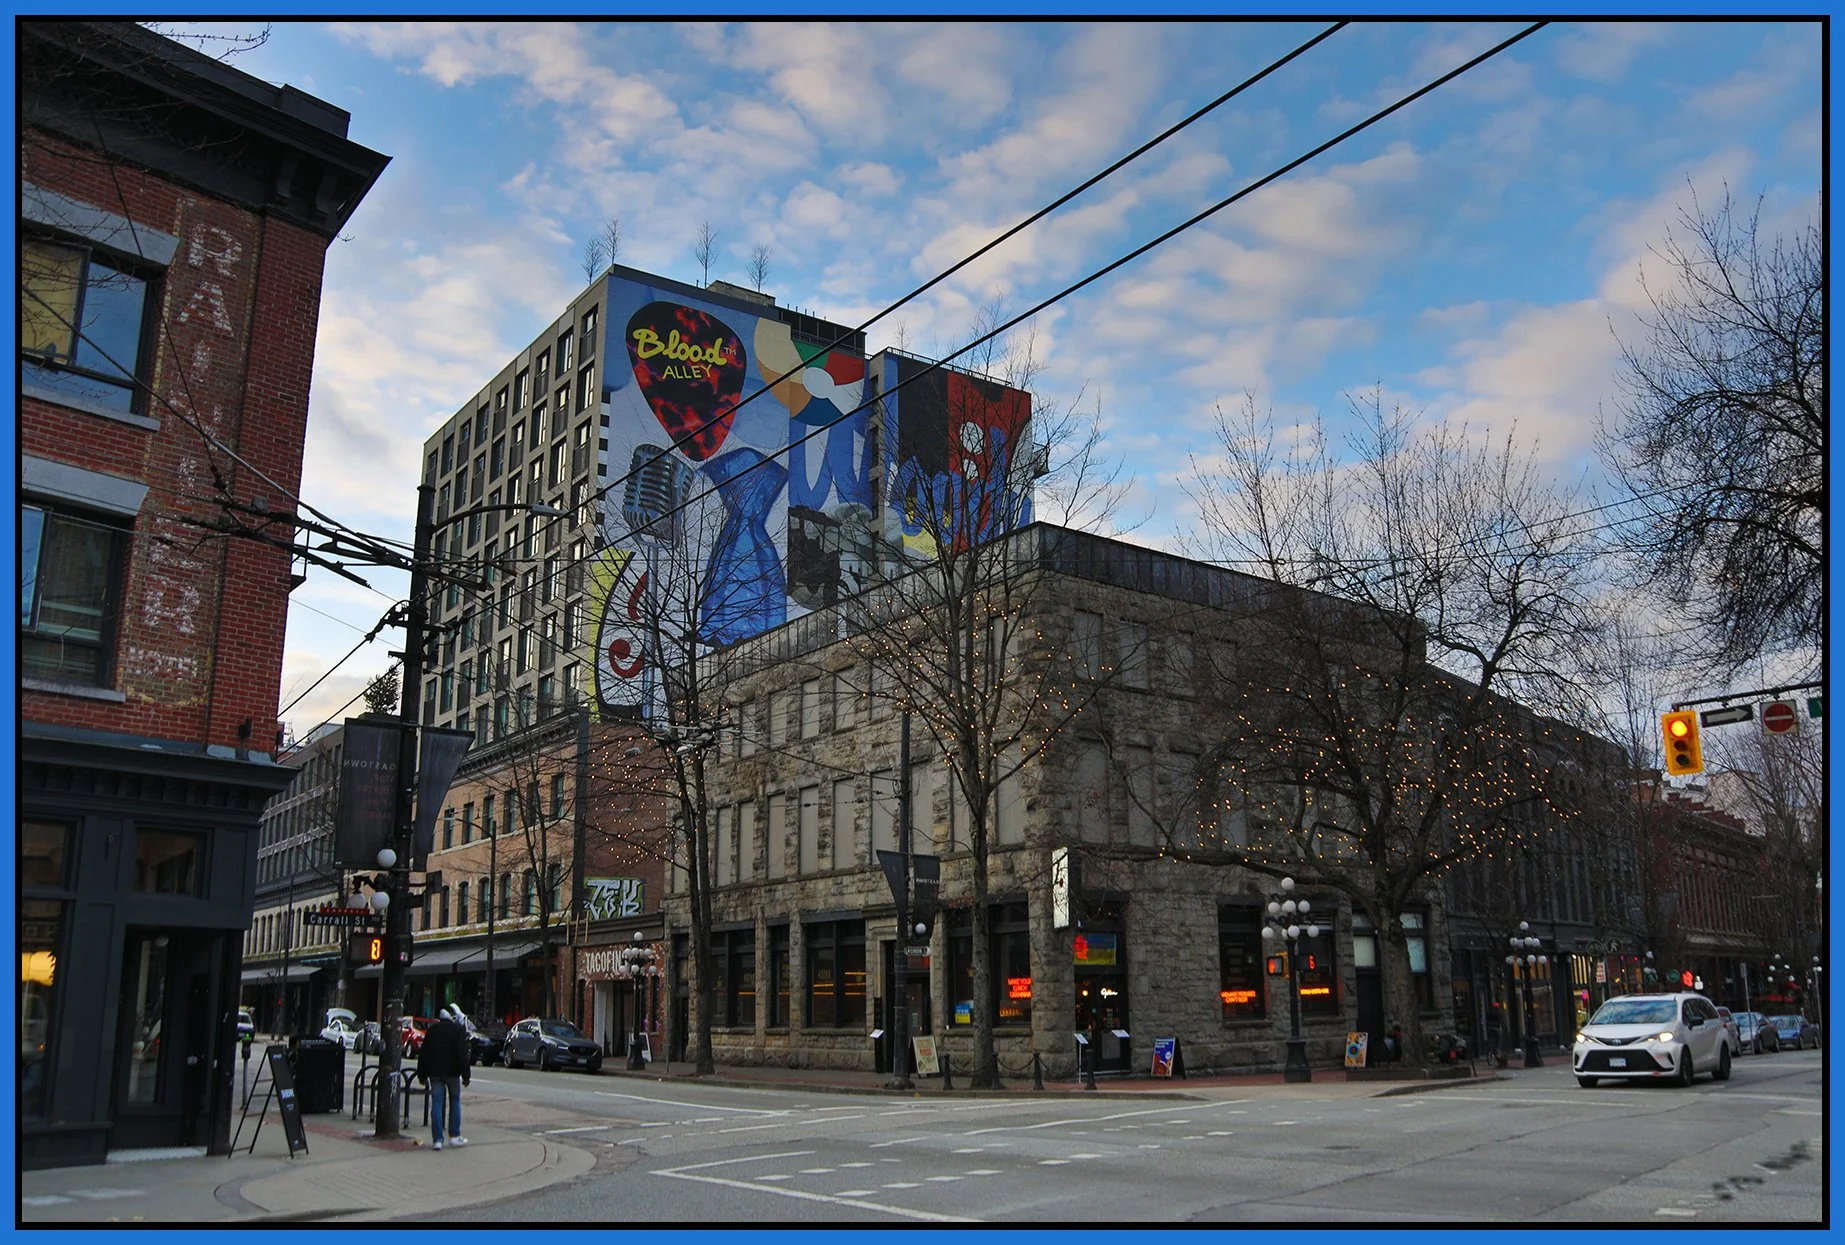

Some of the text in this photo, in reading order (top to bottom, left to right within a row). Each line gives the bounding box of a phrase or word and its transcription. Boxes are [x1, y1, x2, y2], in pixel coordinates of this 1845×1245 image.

[633, 329, 727, 365] Blood
[662, 364, 713, 380] ALLEY
[309, 914, 349, 926] Carrall
[354, 914, 366, 926] St
